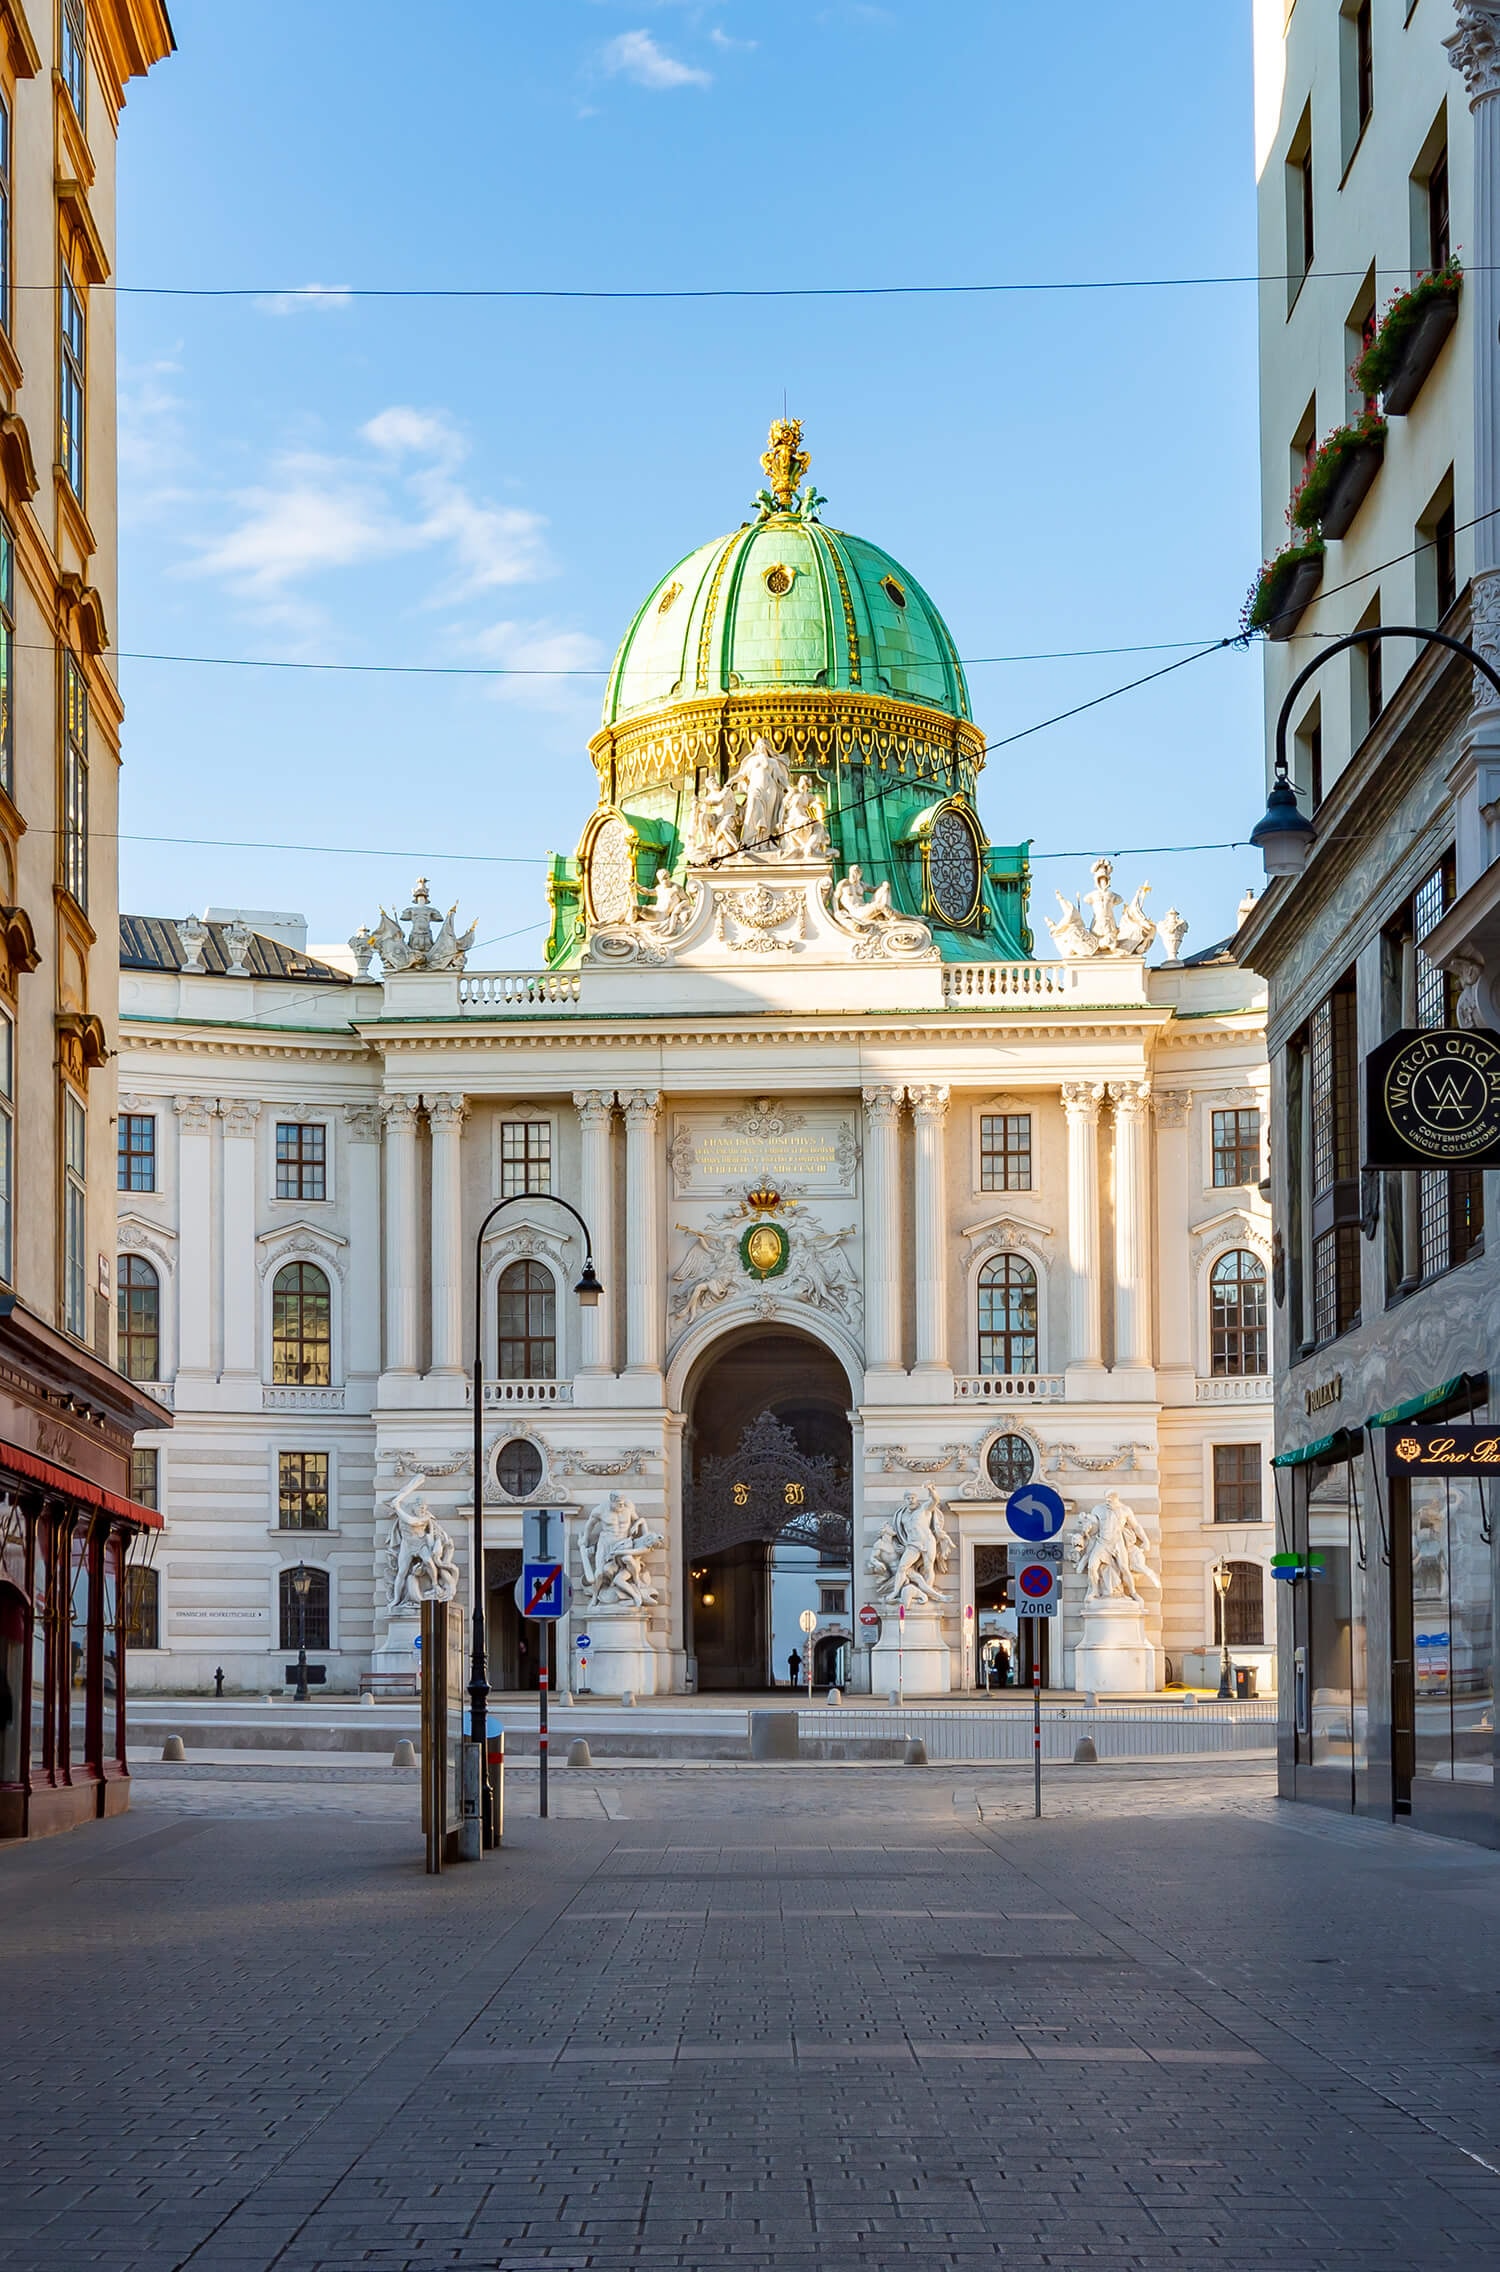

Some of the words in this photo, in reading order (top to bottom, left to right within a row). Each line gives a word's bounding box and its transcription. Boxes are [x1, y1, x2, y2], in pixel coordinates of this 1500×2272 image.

[1390, 1040, 1439, 1109] Watch
[1446, 1040, 1496, 1067] and
[1408, 1129, 1440, 1150] UNIQUE
[1441, 1125, 1498, 1152] COLLECTIONS
[1418, 1121, 1487, 1142] CONTEMPORARY
[1420, 1438, 1470, 1463] Loro
[1021, 1600, 1052, 1614] Zone
